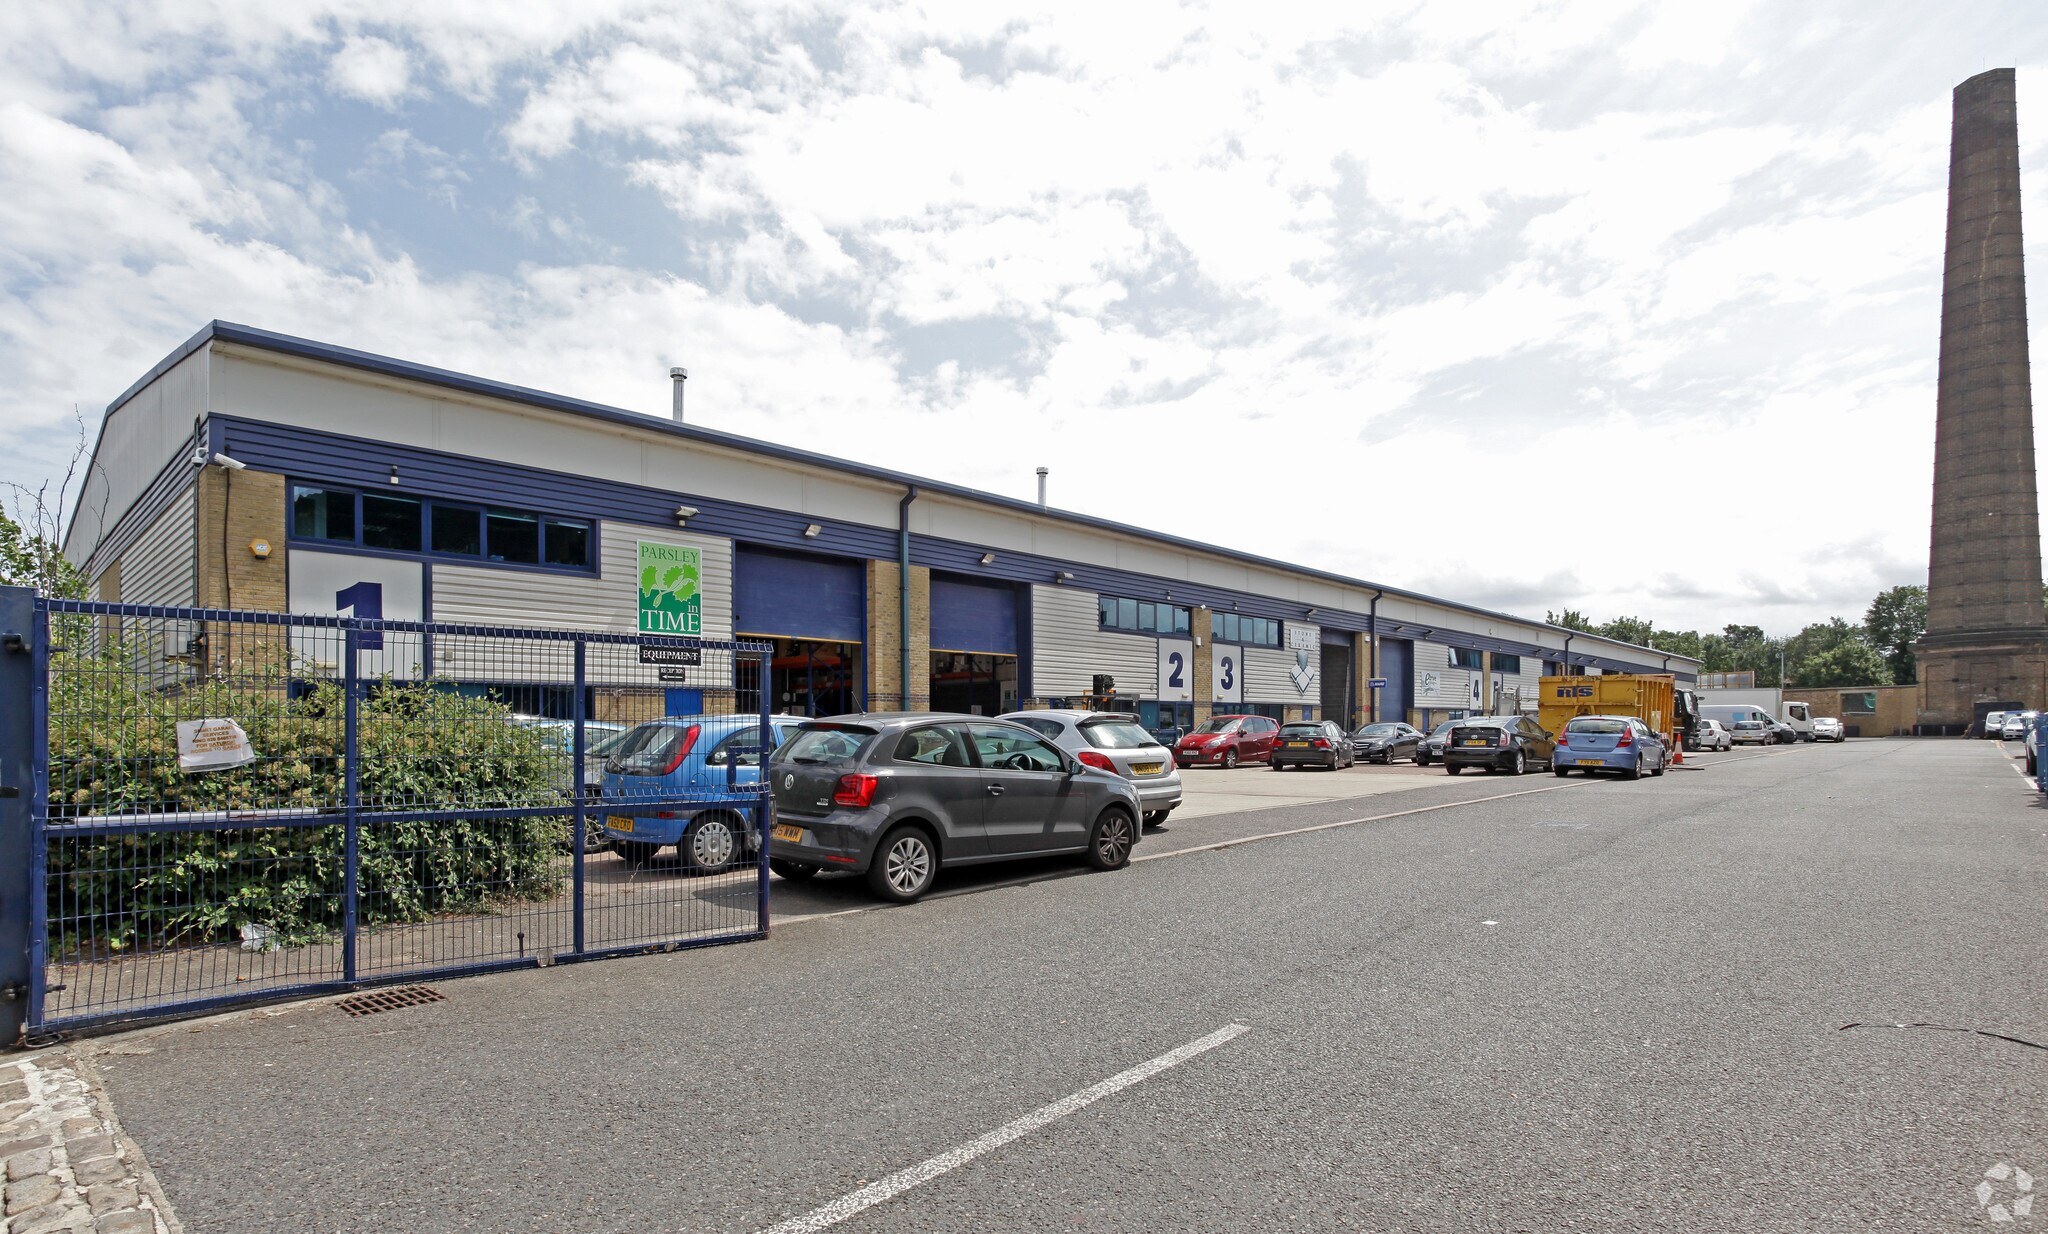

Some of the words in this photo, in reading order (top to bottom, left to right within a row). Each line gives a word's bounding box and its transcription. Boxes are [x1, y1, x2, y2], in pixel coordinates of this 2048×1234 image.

[641, 546, 698, 563] PARSLEY
[336, 582, 383, 650] 1
[688, 602, 698, 613] in
[641, 608, 699, 632] TIME
[642, 649, 698, 661] EQUIPMENT
[1168, 651, 1184, 688] 2
[1220, 656, 1234, 690] 3
[1473, 679, 1479, 701] 4
